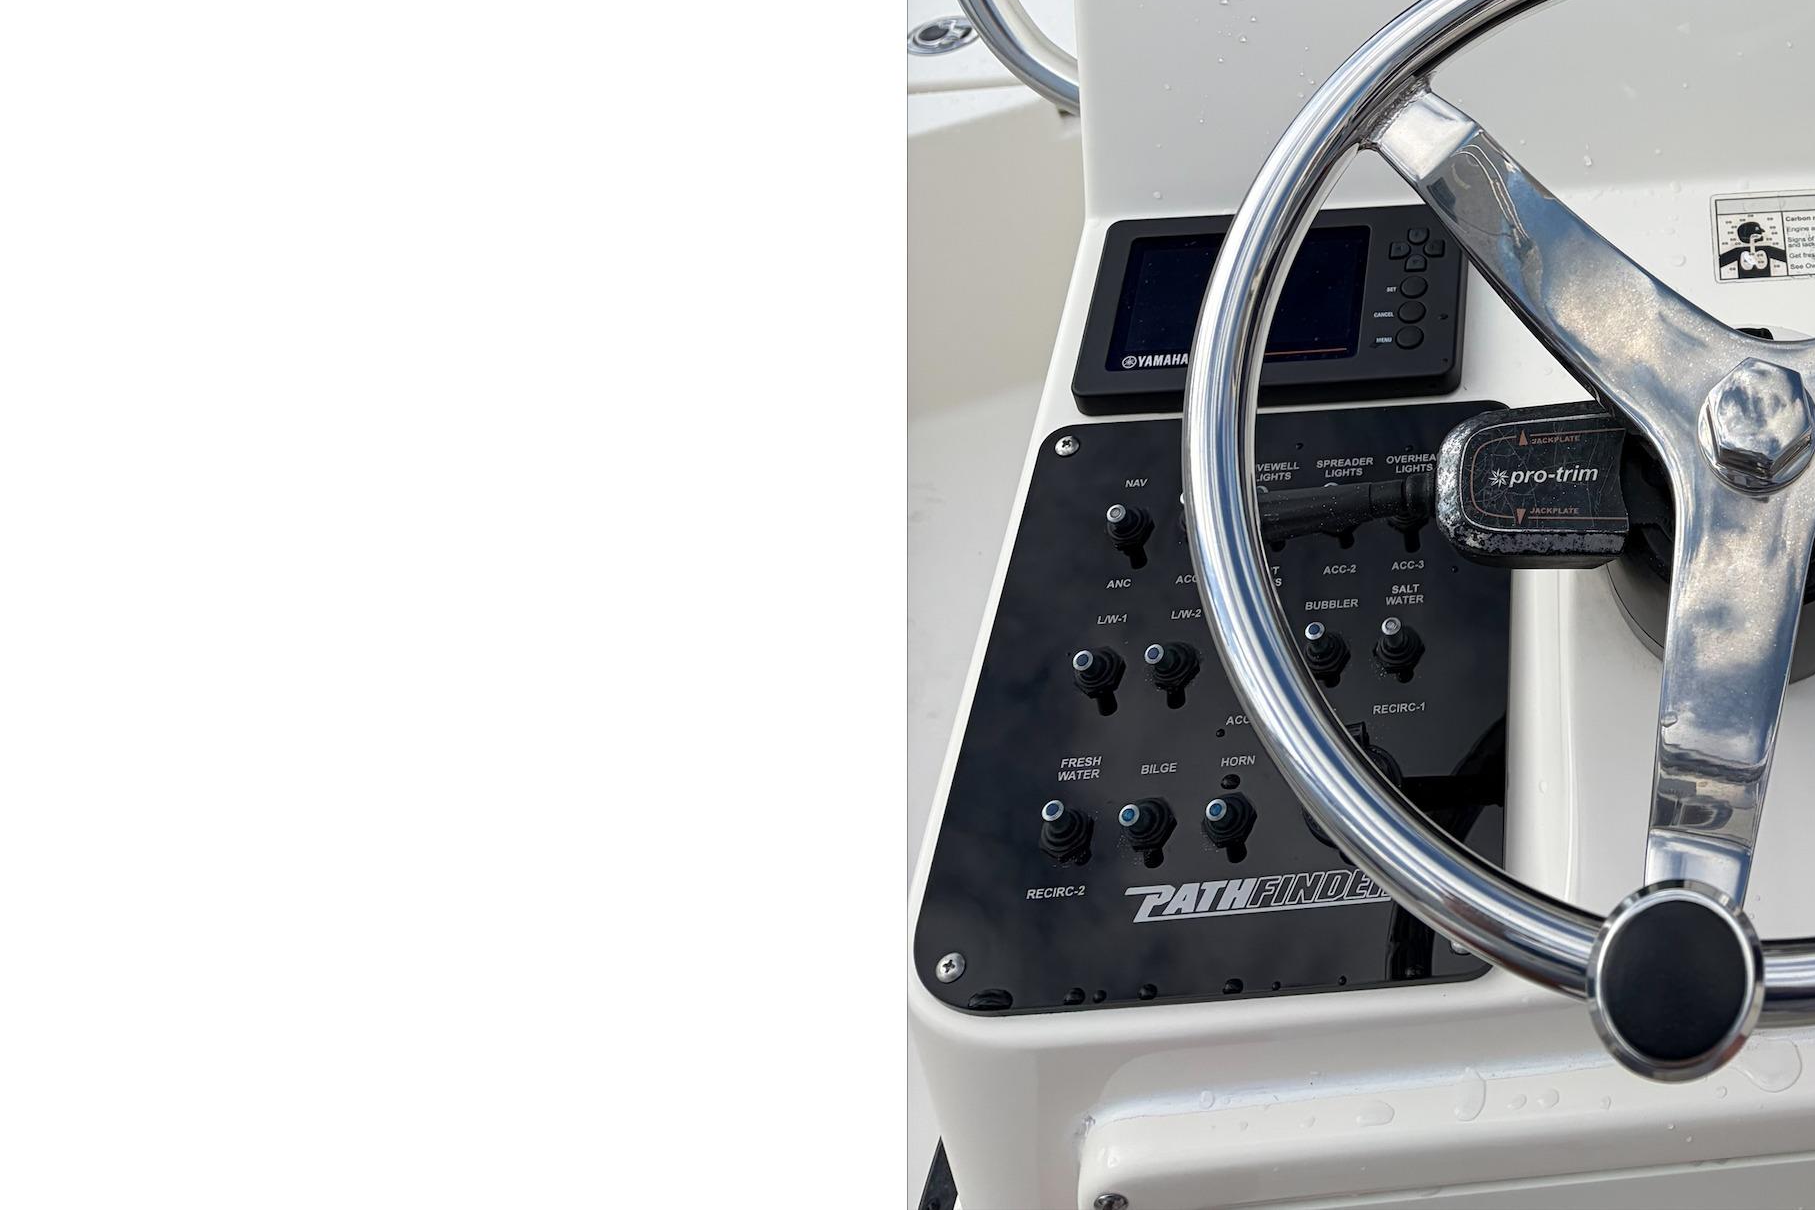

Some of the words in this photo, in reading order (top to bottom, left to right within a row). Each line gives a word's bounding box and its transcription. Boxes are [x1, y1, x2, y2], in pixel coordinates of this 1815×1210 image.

[1138, 353, 1189, 367] YAMAHA
[1531, 435, 1581, 445] JACKPLATE
[1256, 461, 1300, 472] VEWELL
[1316, 456, 1374, 469] SPREADER
[1386, 453, 1437, 465] OVERHEA
[1256, 472, 1292, 482] IGHTS
[1324, 467, 1363, 478] LIGHTS
[1395, 462, 1434, 473] LIGHTS
[1509, 465, 1598, 488] pro-trim
[1125, 478, 1149, 488] NAV
[1529, 507, 1580, 515] JACKPLATE
[1322, 564, 1357, 575] ACC-2
[1391, 559, 1425, 570] ACC-3
[1106, 578, 1132, 589] ANC
[1391, 583, 1420, 594] SALT
[1385, 594, 1424, 607] WATER
[1097, 613, 1128, 625] L/W-1
[1171, 608, 1202, 620] L/W-2
[1304, 598, 1359, 611] BUBBLER
[1372, 701, 1426, 715] RECIRC-1
[1060, 756, 1102, 769] FRESH
[1140, 762, 1178, 775] BILGE
[1220, 755, 1256, 768] HORN
[1057, 768, 1100, 782] WATER
[1026, 885, 1086, 900] RECIRC-2
